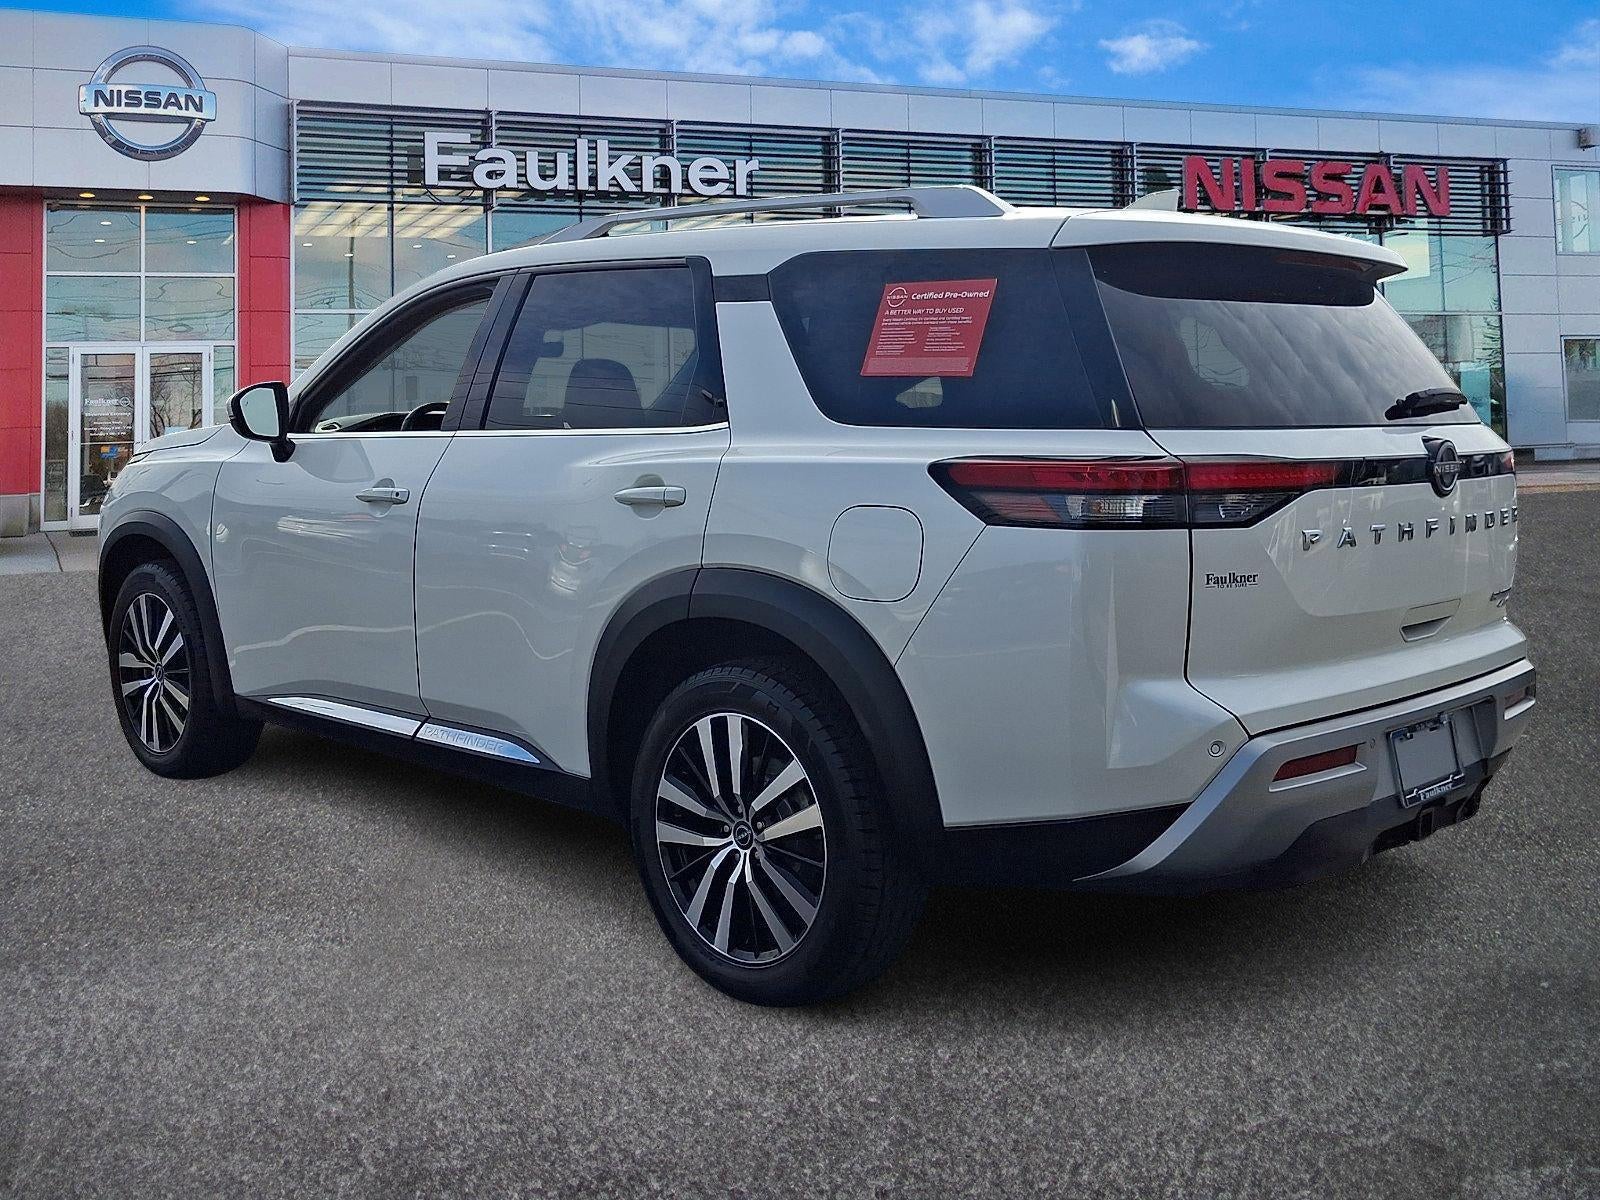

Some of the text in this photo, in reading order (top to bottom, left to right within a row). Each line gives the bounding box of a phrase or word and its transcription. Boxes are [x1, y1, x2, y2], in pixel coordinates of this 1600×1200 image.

[94, 89, 203, 113] NISSAN
[423, 131, 760, 197] Faulkner
[1182, 155, 1450, 217] NISSAN
[911, 290, 990, 300] Certified Pre-Owned
[84, 398, 120, 406] Faulkner
[1434, 464, 1460, 473] NISS
[1205, 572, 1259, 585] Faulkner
[424, 726, 504, 752] PATHFINDER
[1420, 783, 1453, 801] Faulkner
